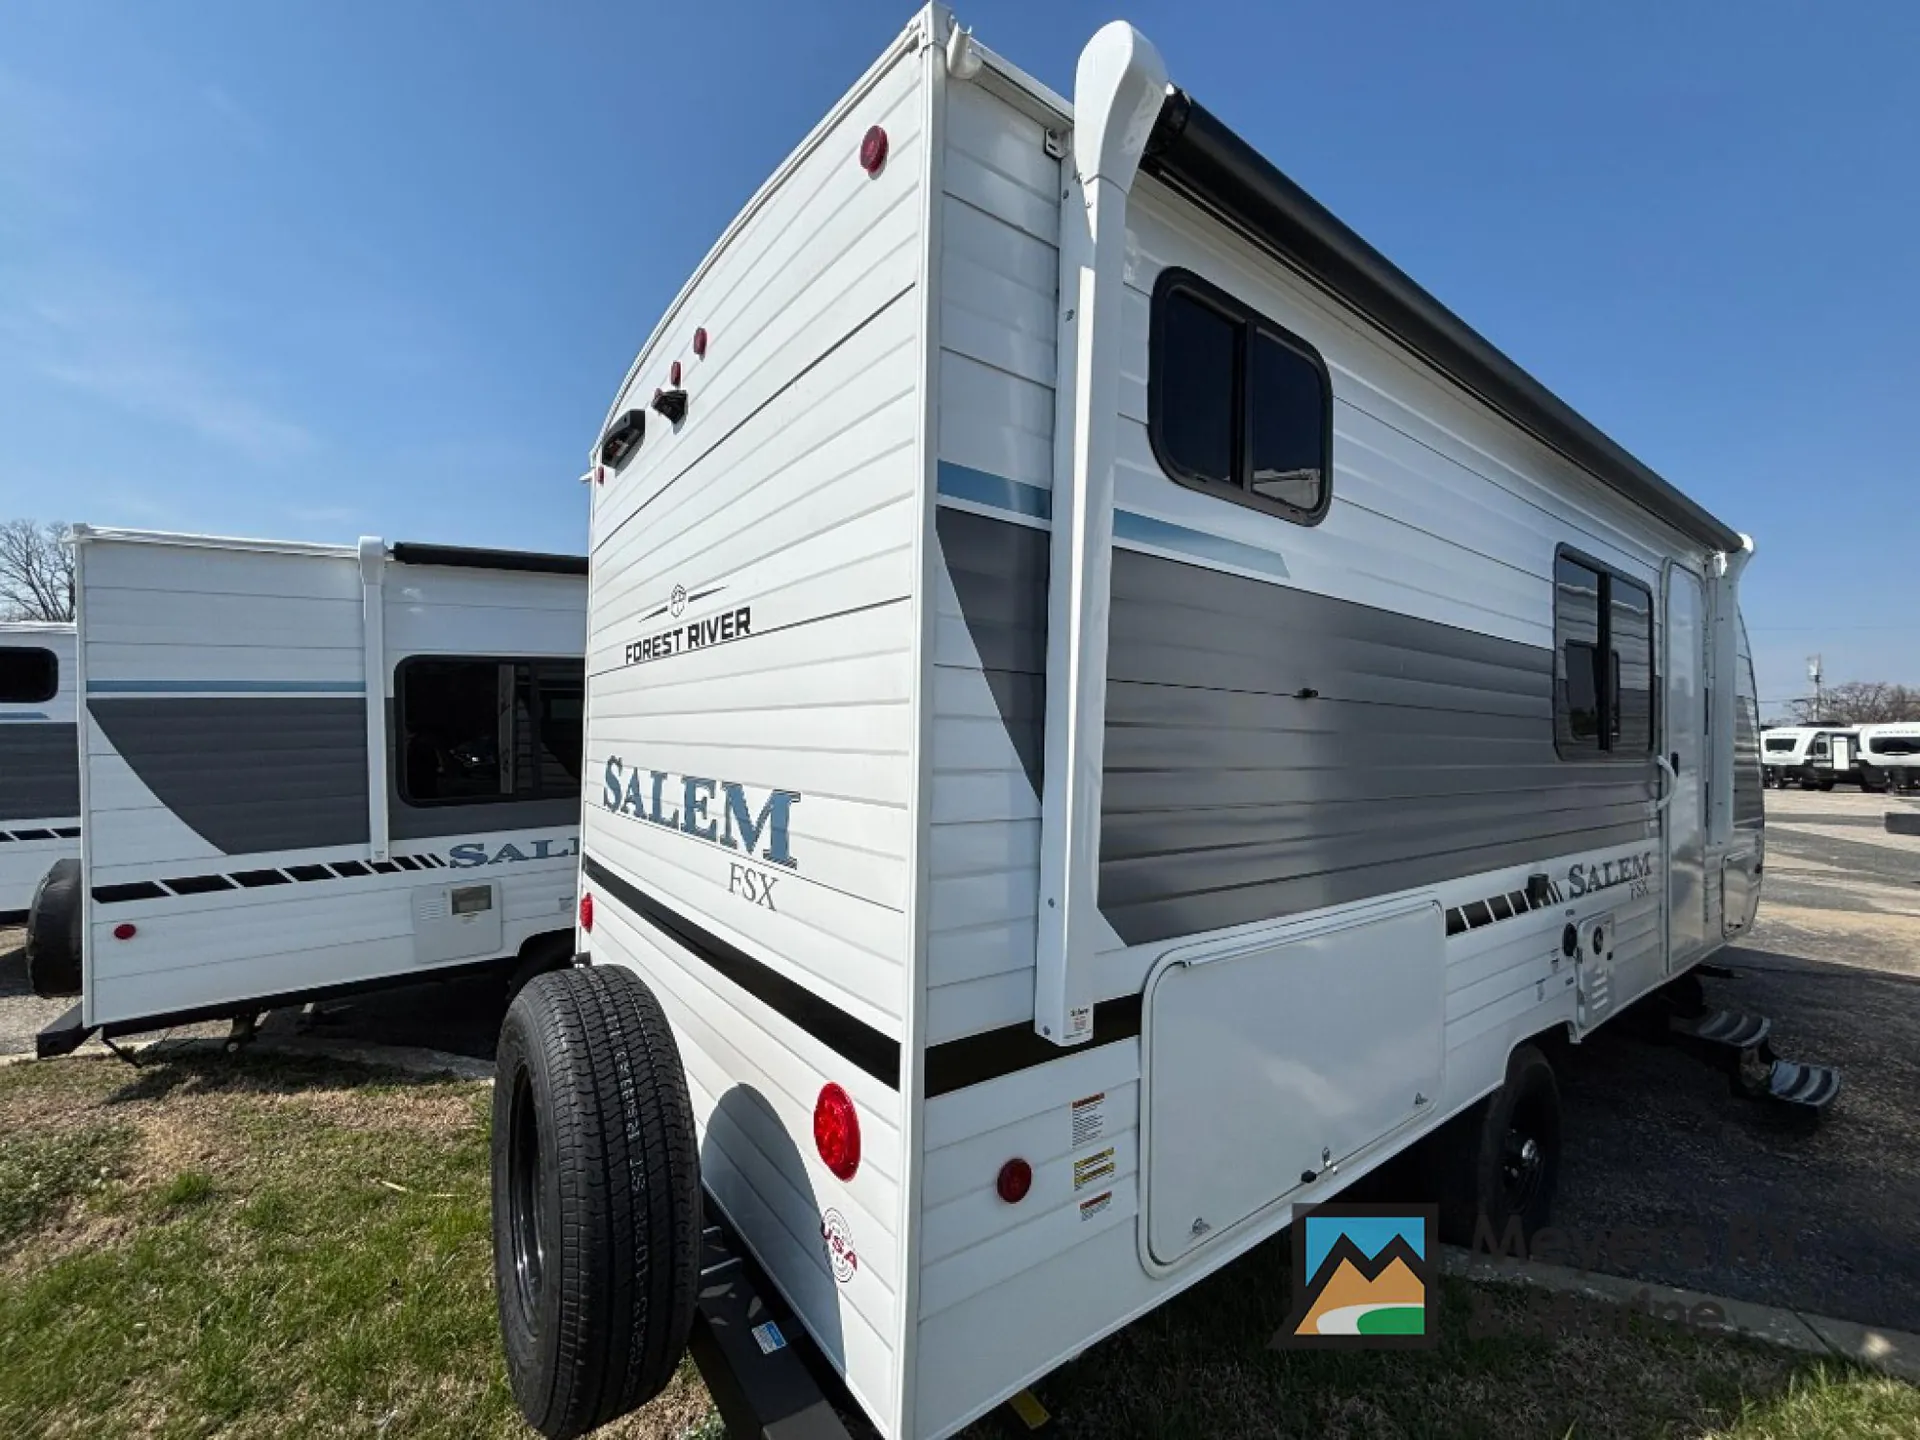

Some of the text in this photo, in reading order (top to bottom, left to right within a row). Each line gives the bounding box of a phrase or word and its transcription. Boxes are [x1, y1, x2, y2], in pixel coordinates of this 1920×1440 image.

[625, 606, 751, 665] FOREST RIVER
[603, 755, 801, 870] SALEM
[729, 862, 779, 912] FSX
[1568, 851, 1652, 899] SALEM
